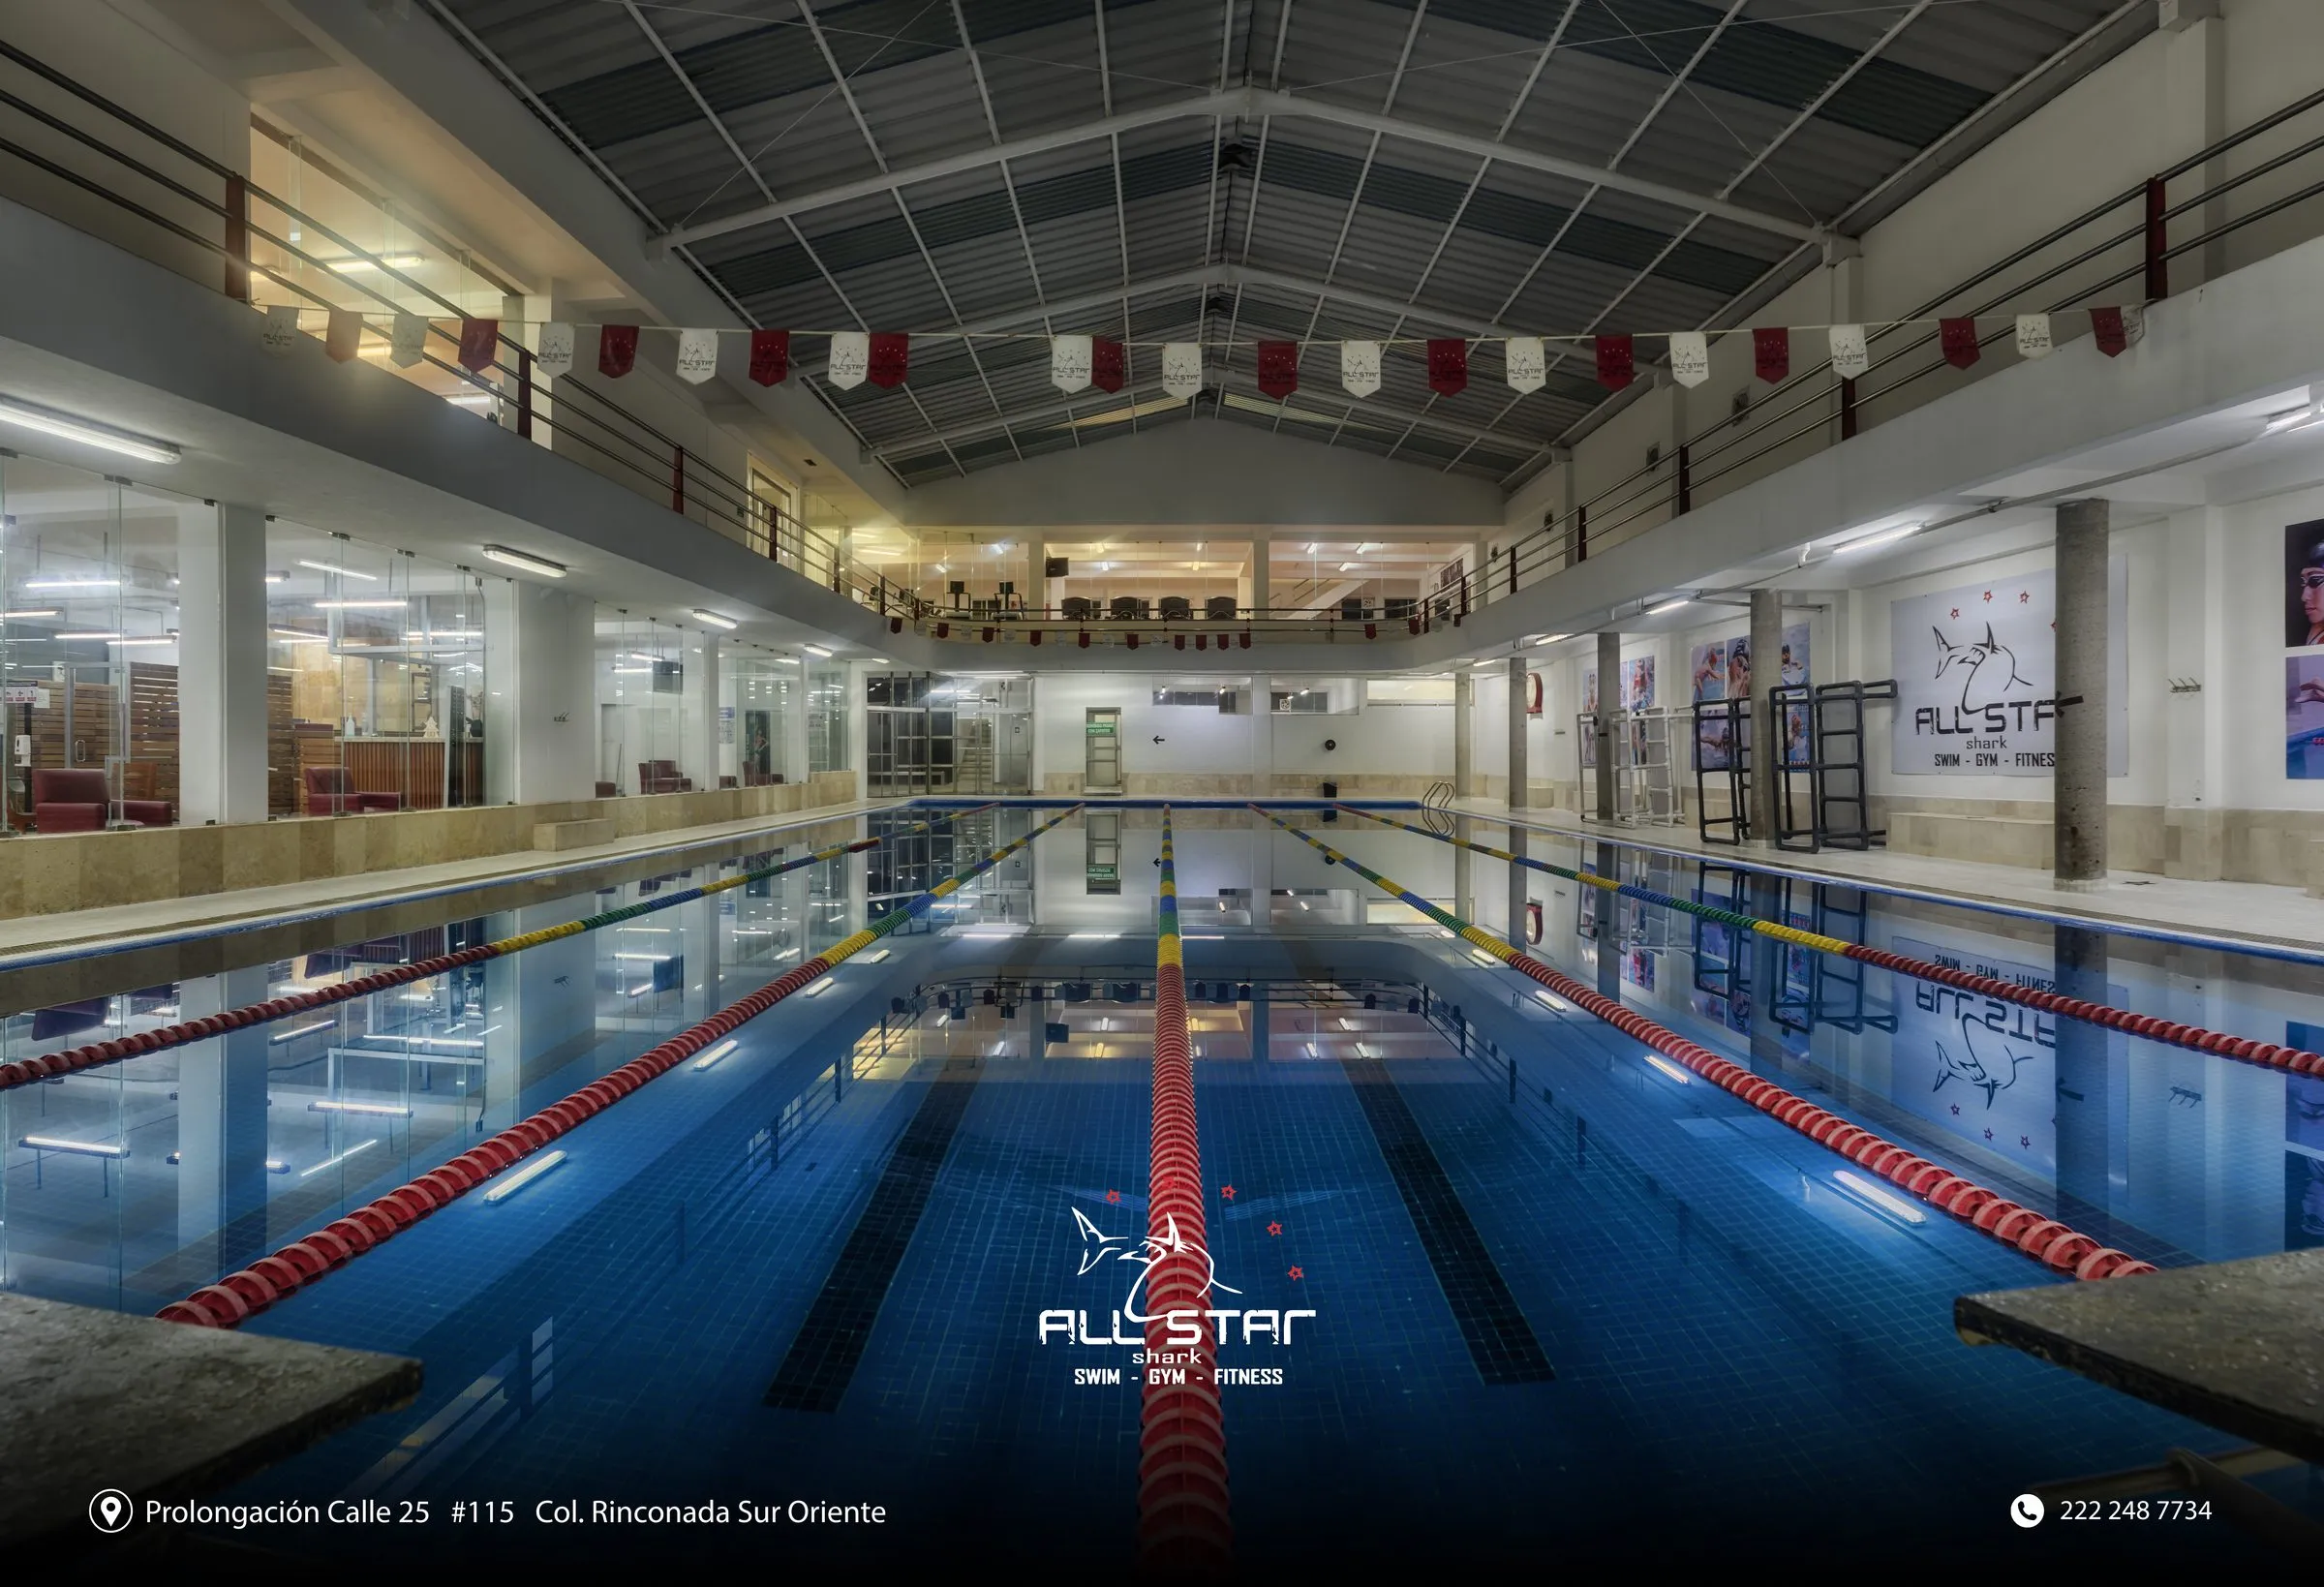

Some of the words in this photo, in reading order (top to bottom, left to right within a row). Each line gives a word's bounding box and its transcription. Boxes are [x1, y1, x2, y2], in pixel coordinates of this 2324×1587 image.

[1915, 706, 1973, 735] ALL
[1985, 699, 2056, 733] STA
[1966, 736, 2007, 749] shark
[1935, 754, 1960, 767] SWIM
[1975, 753, 1999, 767] GYM
[2015, 752, 2056, 767] FITNES
